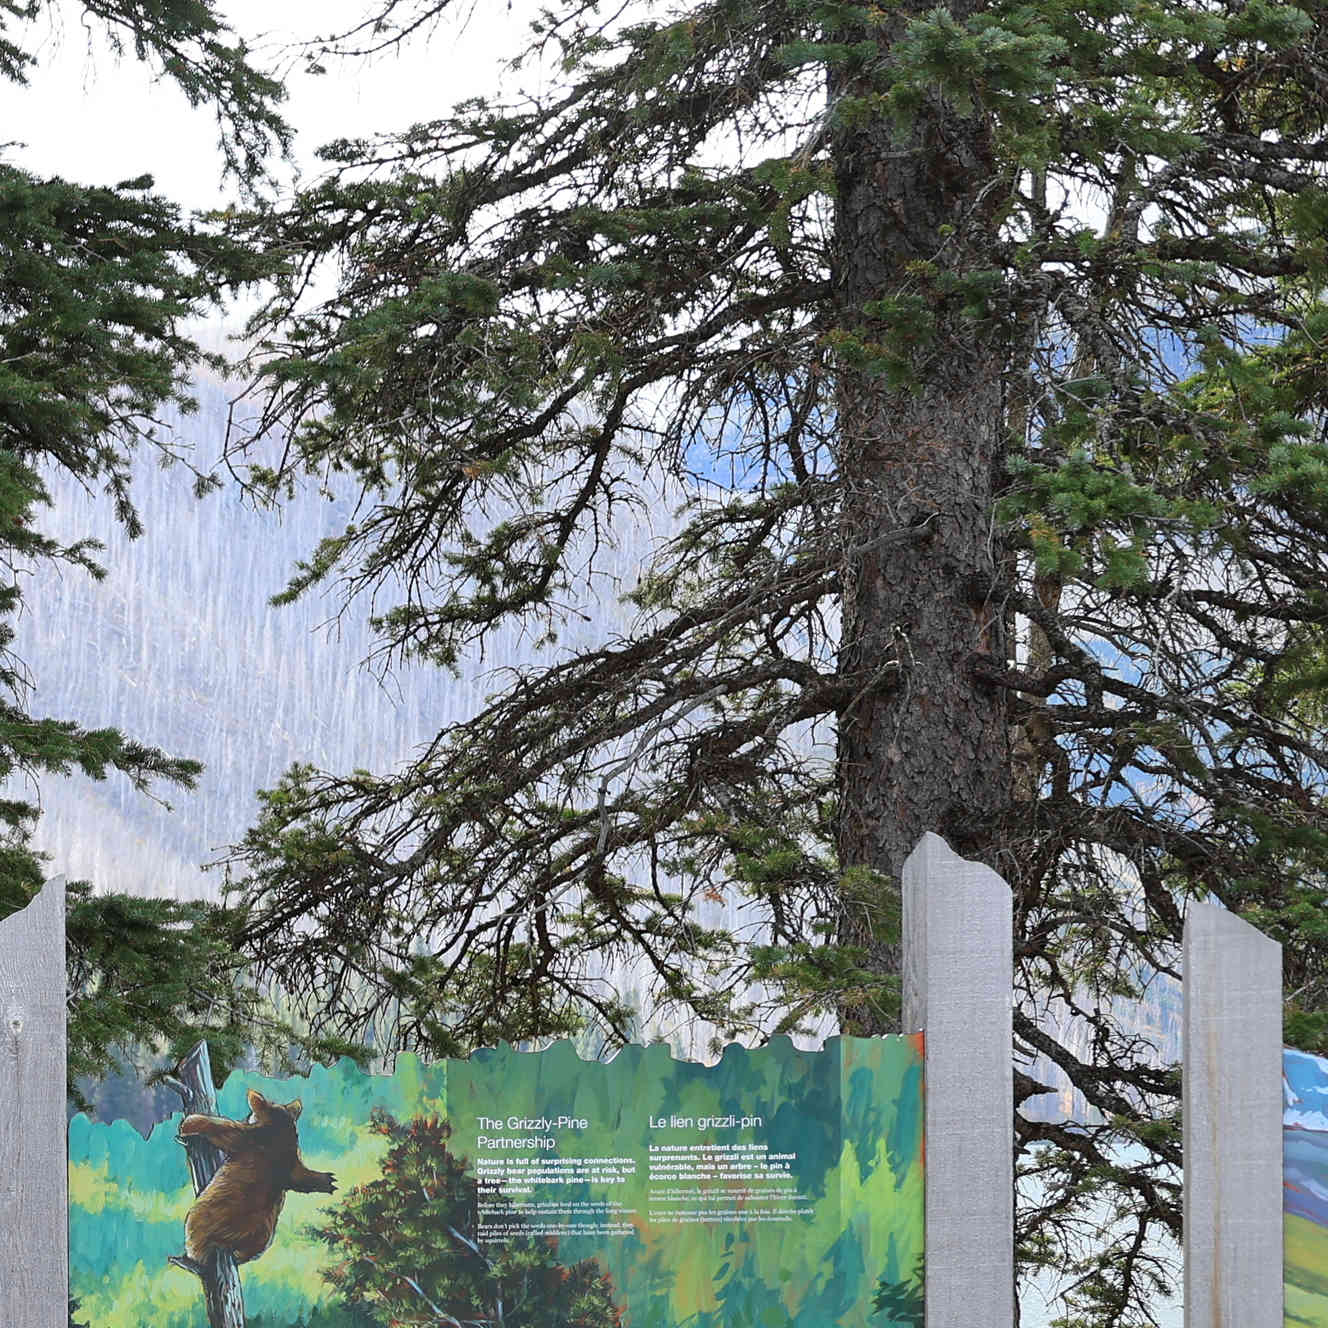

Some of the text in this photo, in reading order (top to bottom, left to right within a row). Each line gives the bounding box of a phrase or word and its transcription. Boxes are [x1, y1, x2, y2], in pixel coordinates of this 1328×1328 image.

[477, 1116, 589, 1132] The Grizzly-Pine
[649, 1115, 762, 1131] Le lien grizzli-pin
[477, 1136, 556, 1150] Partnership
[541, 1158, 582, 1166] surprising
[714, 1153, 739, 1162] grizzli
[477, 1168, 504, 1176] Grizzly
[528, 1167, 574, 1176] populations
[602, 1166, 620, 1174] risk,
[649, 1163, 694, 1171] vulnérable,
[770, 1162, 783, 1171] pin
[600, 1176, 615, 1184] key
[649, 1172, 677, 1180] écorce
